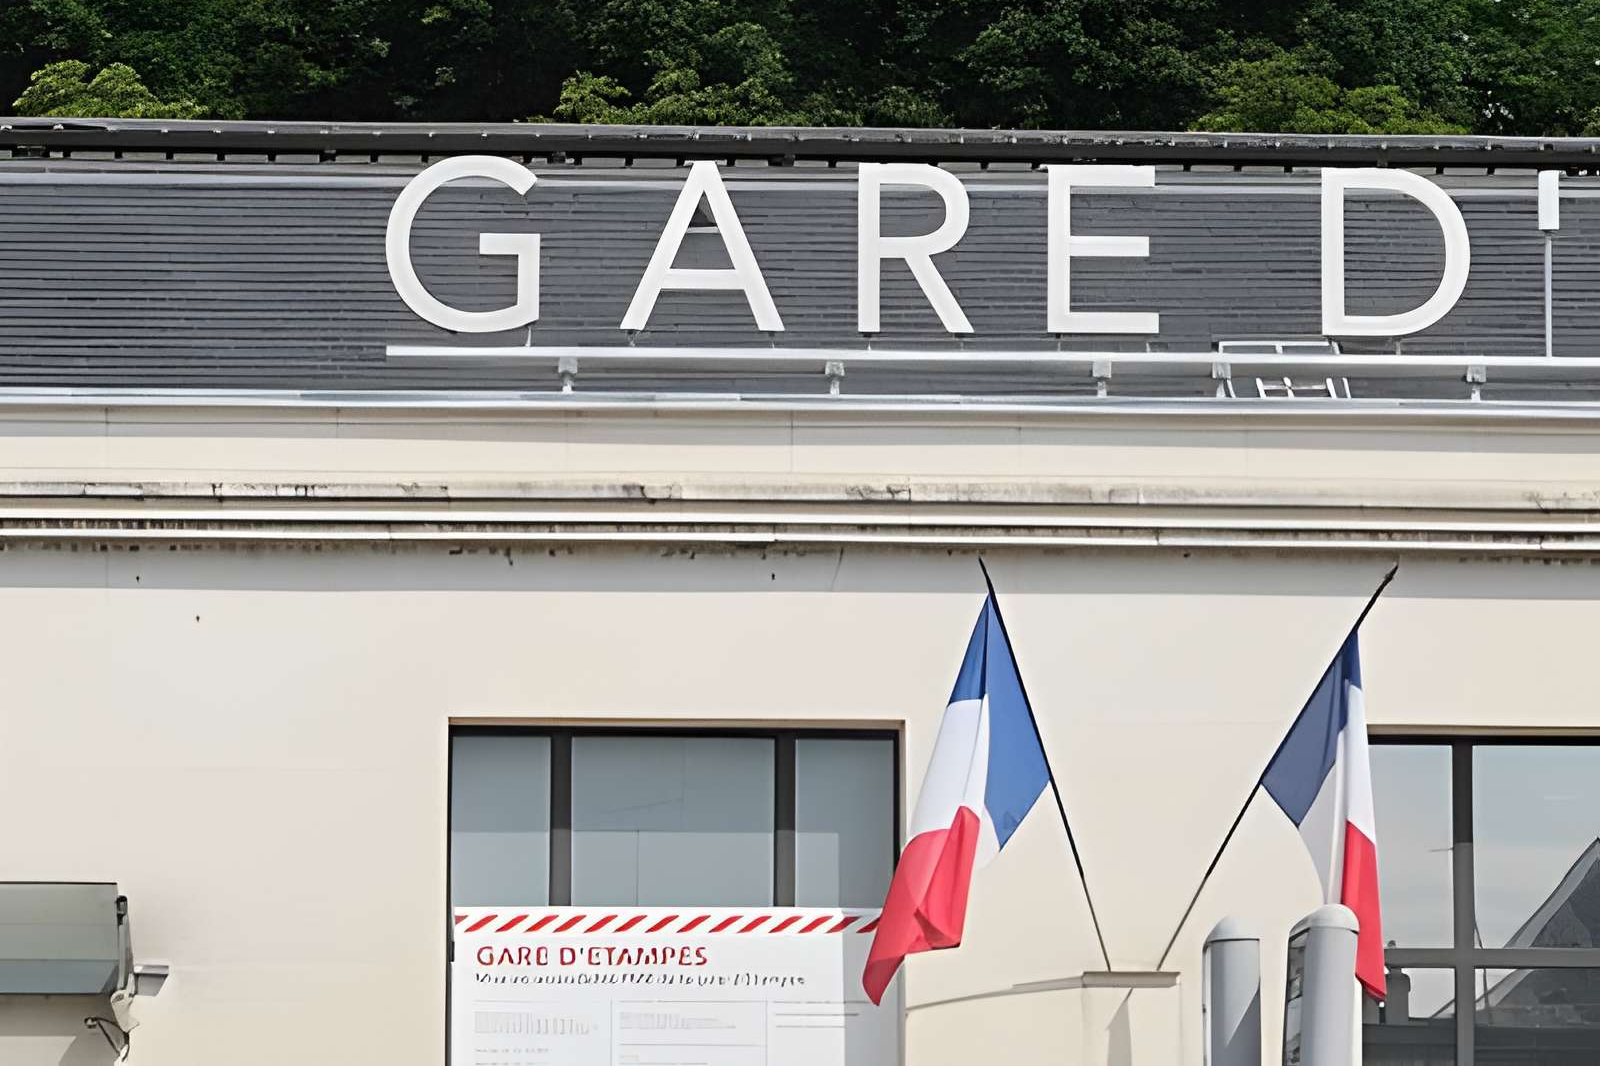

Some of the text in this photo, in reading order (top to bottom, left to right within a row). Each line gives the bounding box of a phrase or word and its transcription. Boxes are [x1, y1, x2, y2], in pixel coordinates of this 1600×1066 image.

[385, 155, 1560, 338] GARE D'
[477, 945, 548, 966] GARE
